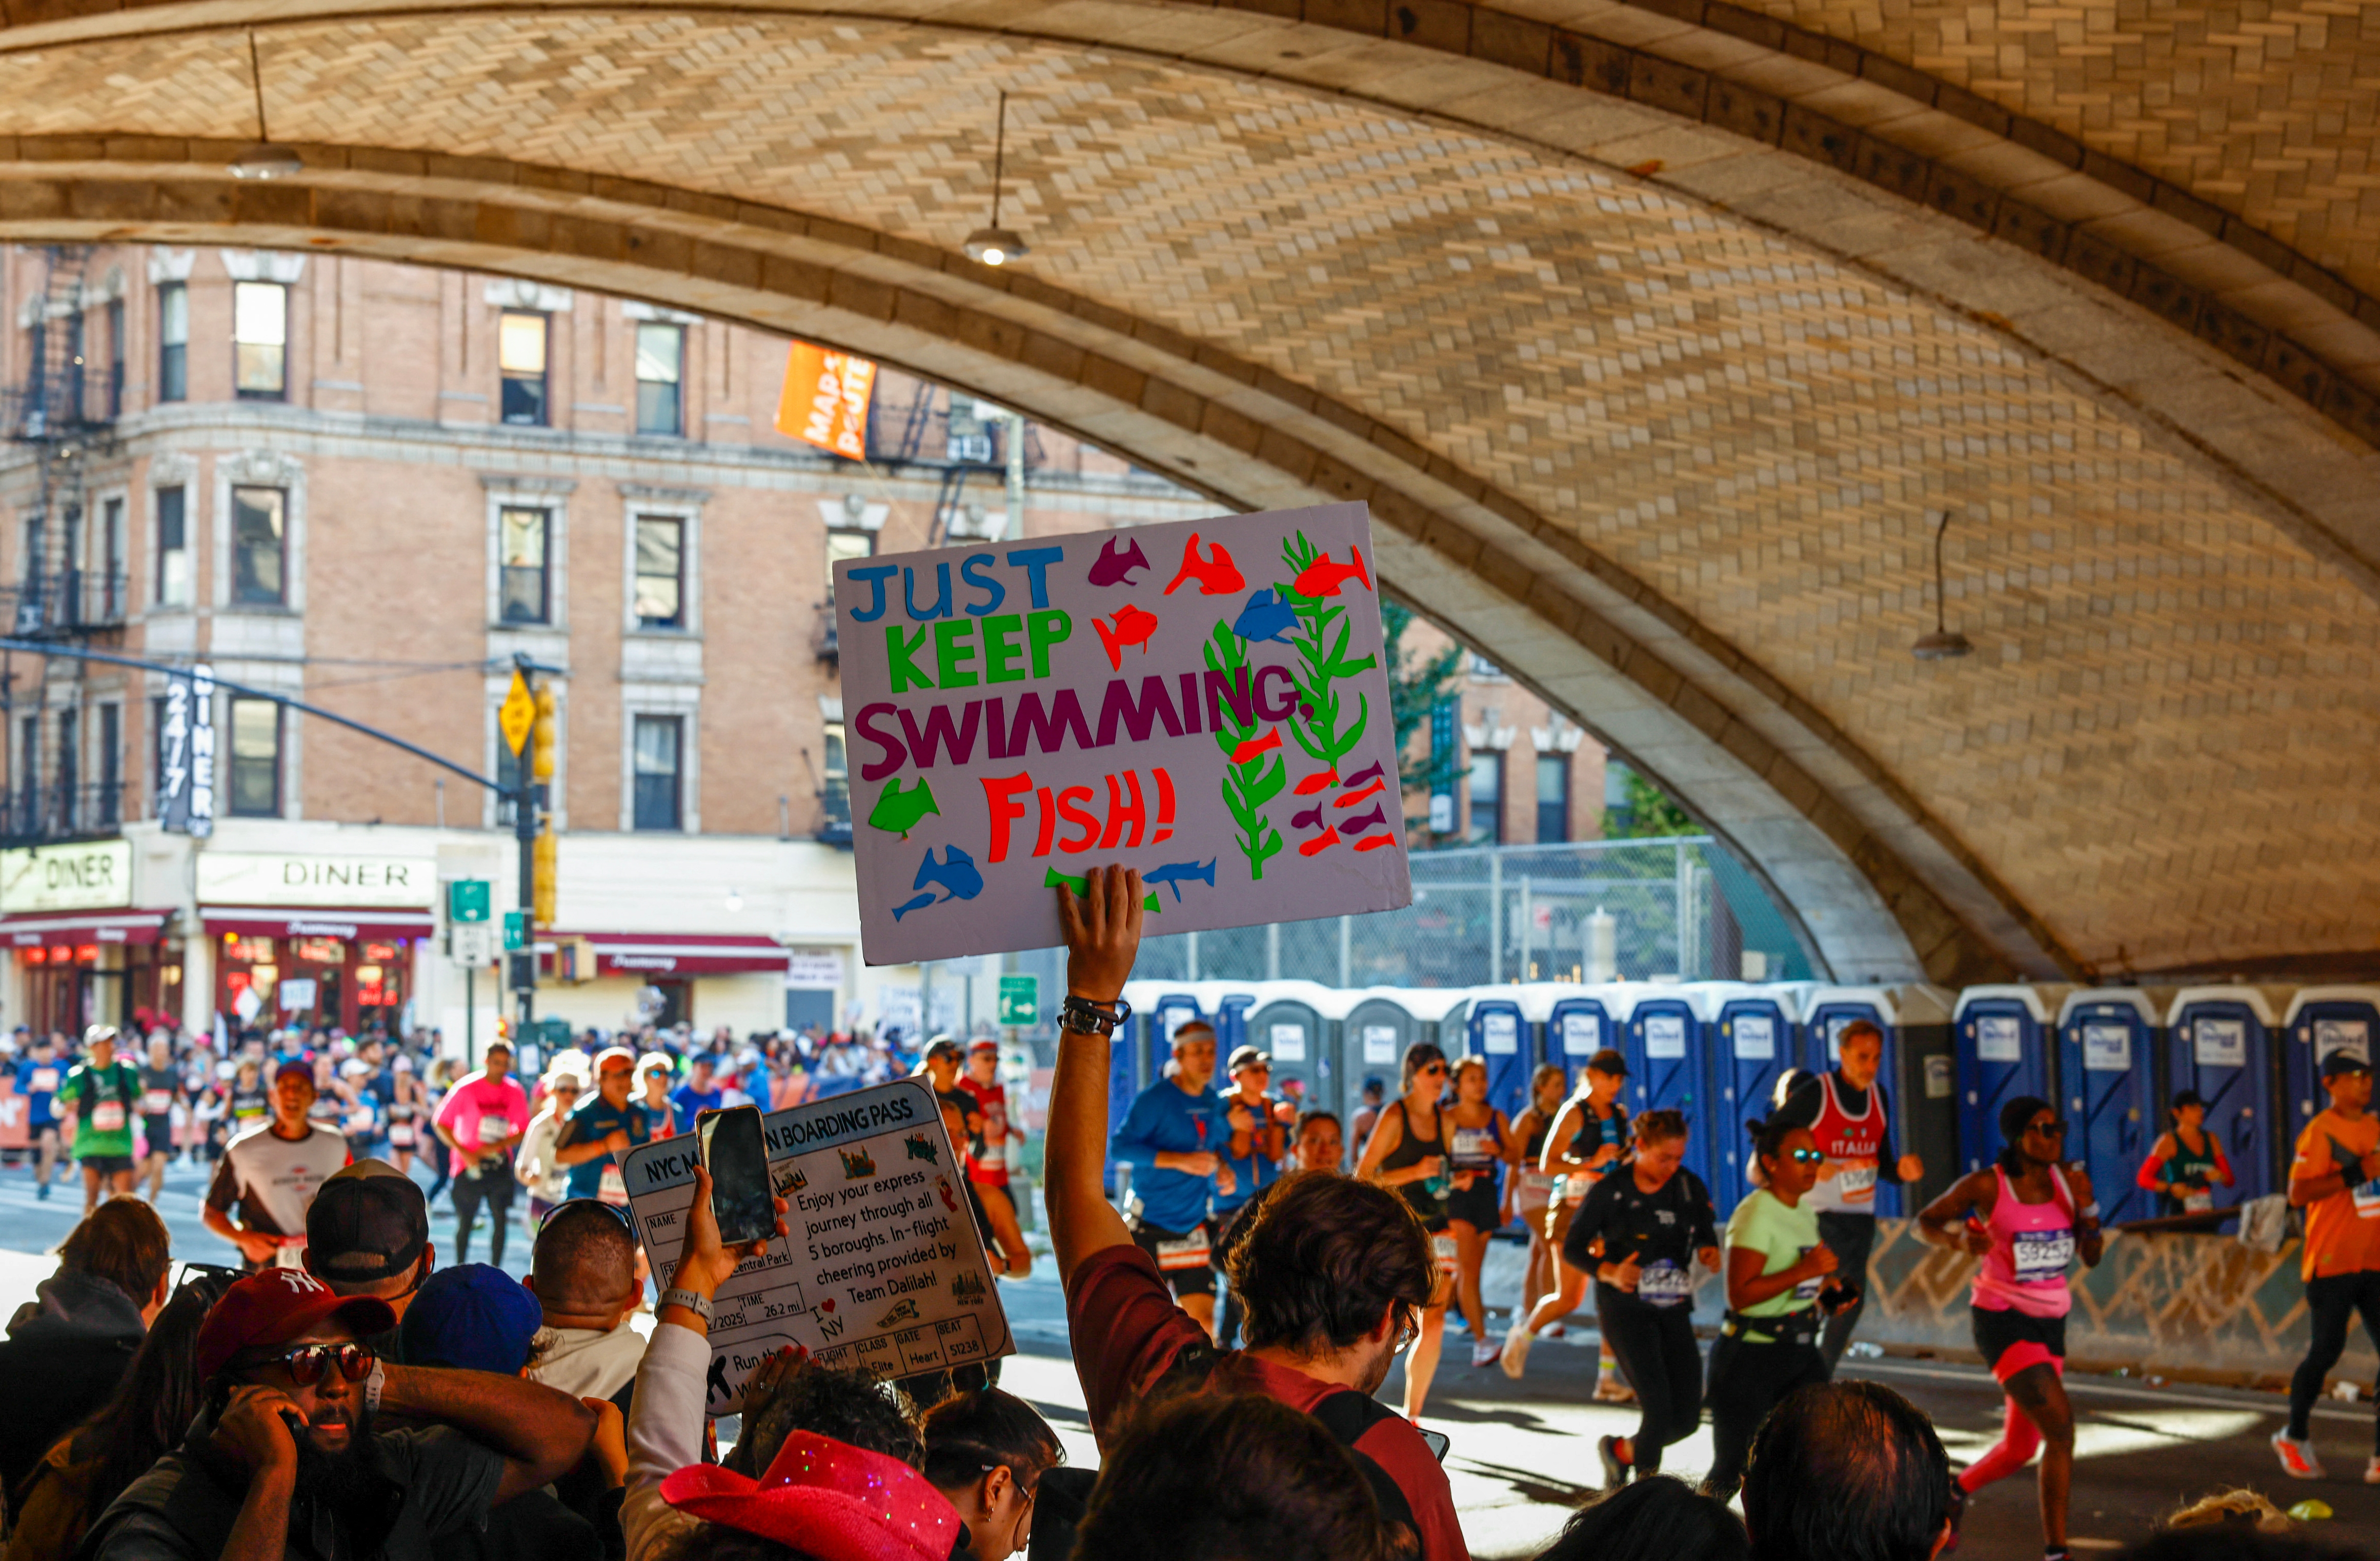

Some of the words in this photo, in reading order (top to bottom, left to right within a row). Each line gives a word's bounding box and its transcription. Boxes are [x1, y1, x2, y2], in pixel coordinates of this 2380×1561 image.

[848, 546, 1063, 622] JUST
[885, 609, 1072, 693] KEEP
[855, 665, 1314, 781] SWIMMING,
[190, 664, 214, 818] DINER
[980, 767, 1176, 863] FISH!
[47, 855, 113, 889] DINER
[284, 861, 408, 886] DINER
[781, 1107, 869, 1148] BOARDING
[869, 1097, 913, 1127] PASS
[1831, 1139, 1877, 1155] ITALIA
[645, 1156, 681, 1183] NYC
[797, 1192, 834, 1212] Enjoy
[839, 1183, 868, 1205] your
[874, 1171, 925, 1193] express
[650, 1213, 677, 1229] NAME
[805, 1213, 856, 1239] journey
[860, 1196, 914, 1217] through
[918, 1191, 933, 1209] all
[809, 1245, 819, 1260] 5
[821, 1231, 889, 1257] boroughs.
[890, 1216, 950, 1242] In-flight
[767, 1251, 789, 1266] Park
[817, 1262, 875, 1285] cheering
[877, 1243, 937, 1274] provided
[938, 1242, 956, 1259] by
[280, 1271, 325, 1294] NY
[847, 1286, 886, 1304] Team
[887, 1270, 938, 1295] Dalilah!
[741, 1293, 765, 1307] TIME
[764, 1303, 785, 1318] 26.2
[788, 1300, 800, 1312] mi
[810, 1306, 823, 1324] I
[938, 1320, 962, 1334] SEAT
[820, 1315, 843, 1342] NY
[897, 1330, 921, 1344] GATE
[857, 1338, 888, 1354] CLASS
[909, 1351, 939, 1365] Heart
[950, 1340, 979, 1356] 51238
[733, 1355, 760, 1372] Run
[872, 1360, 894, 1373] Elite
